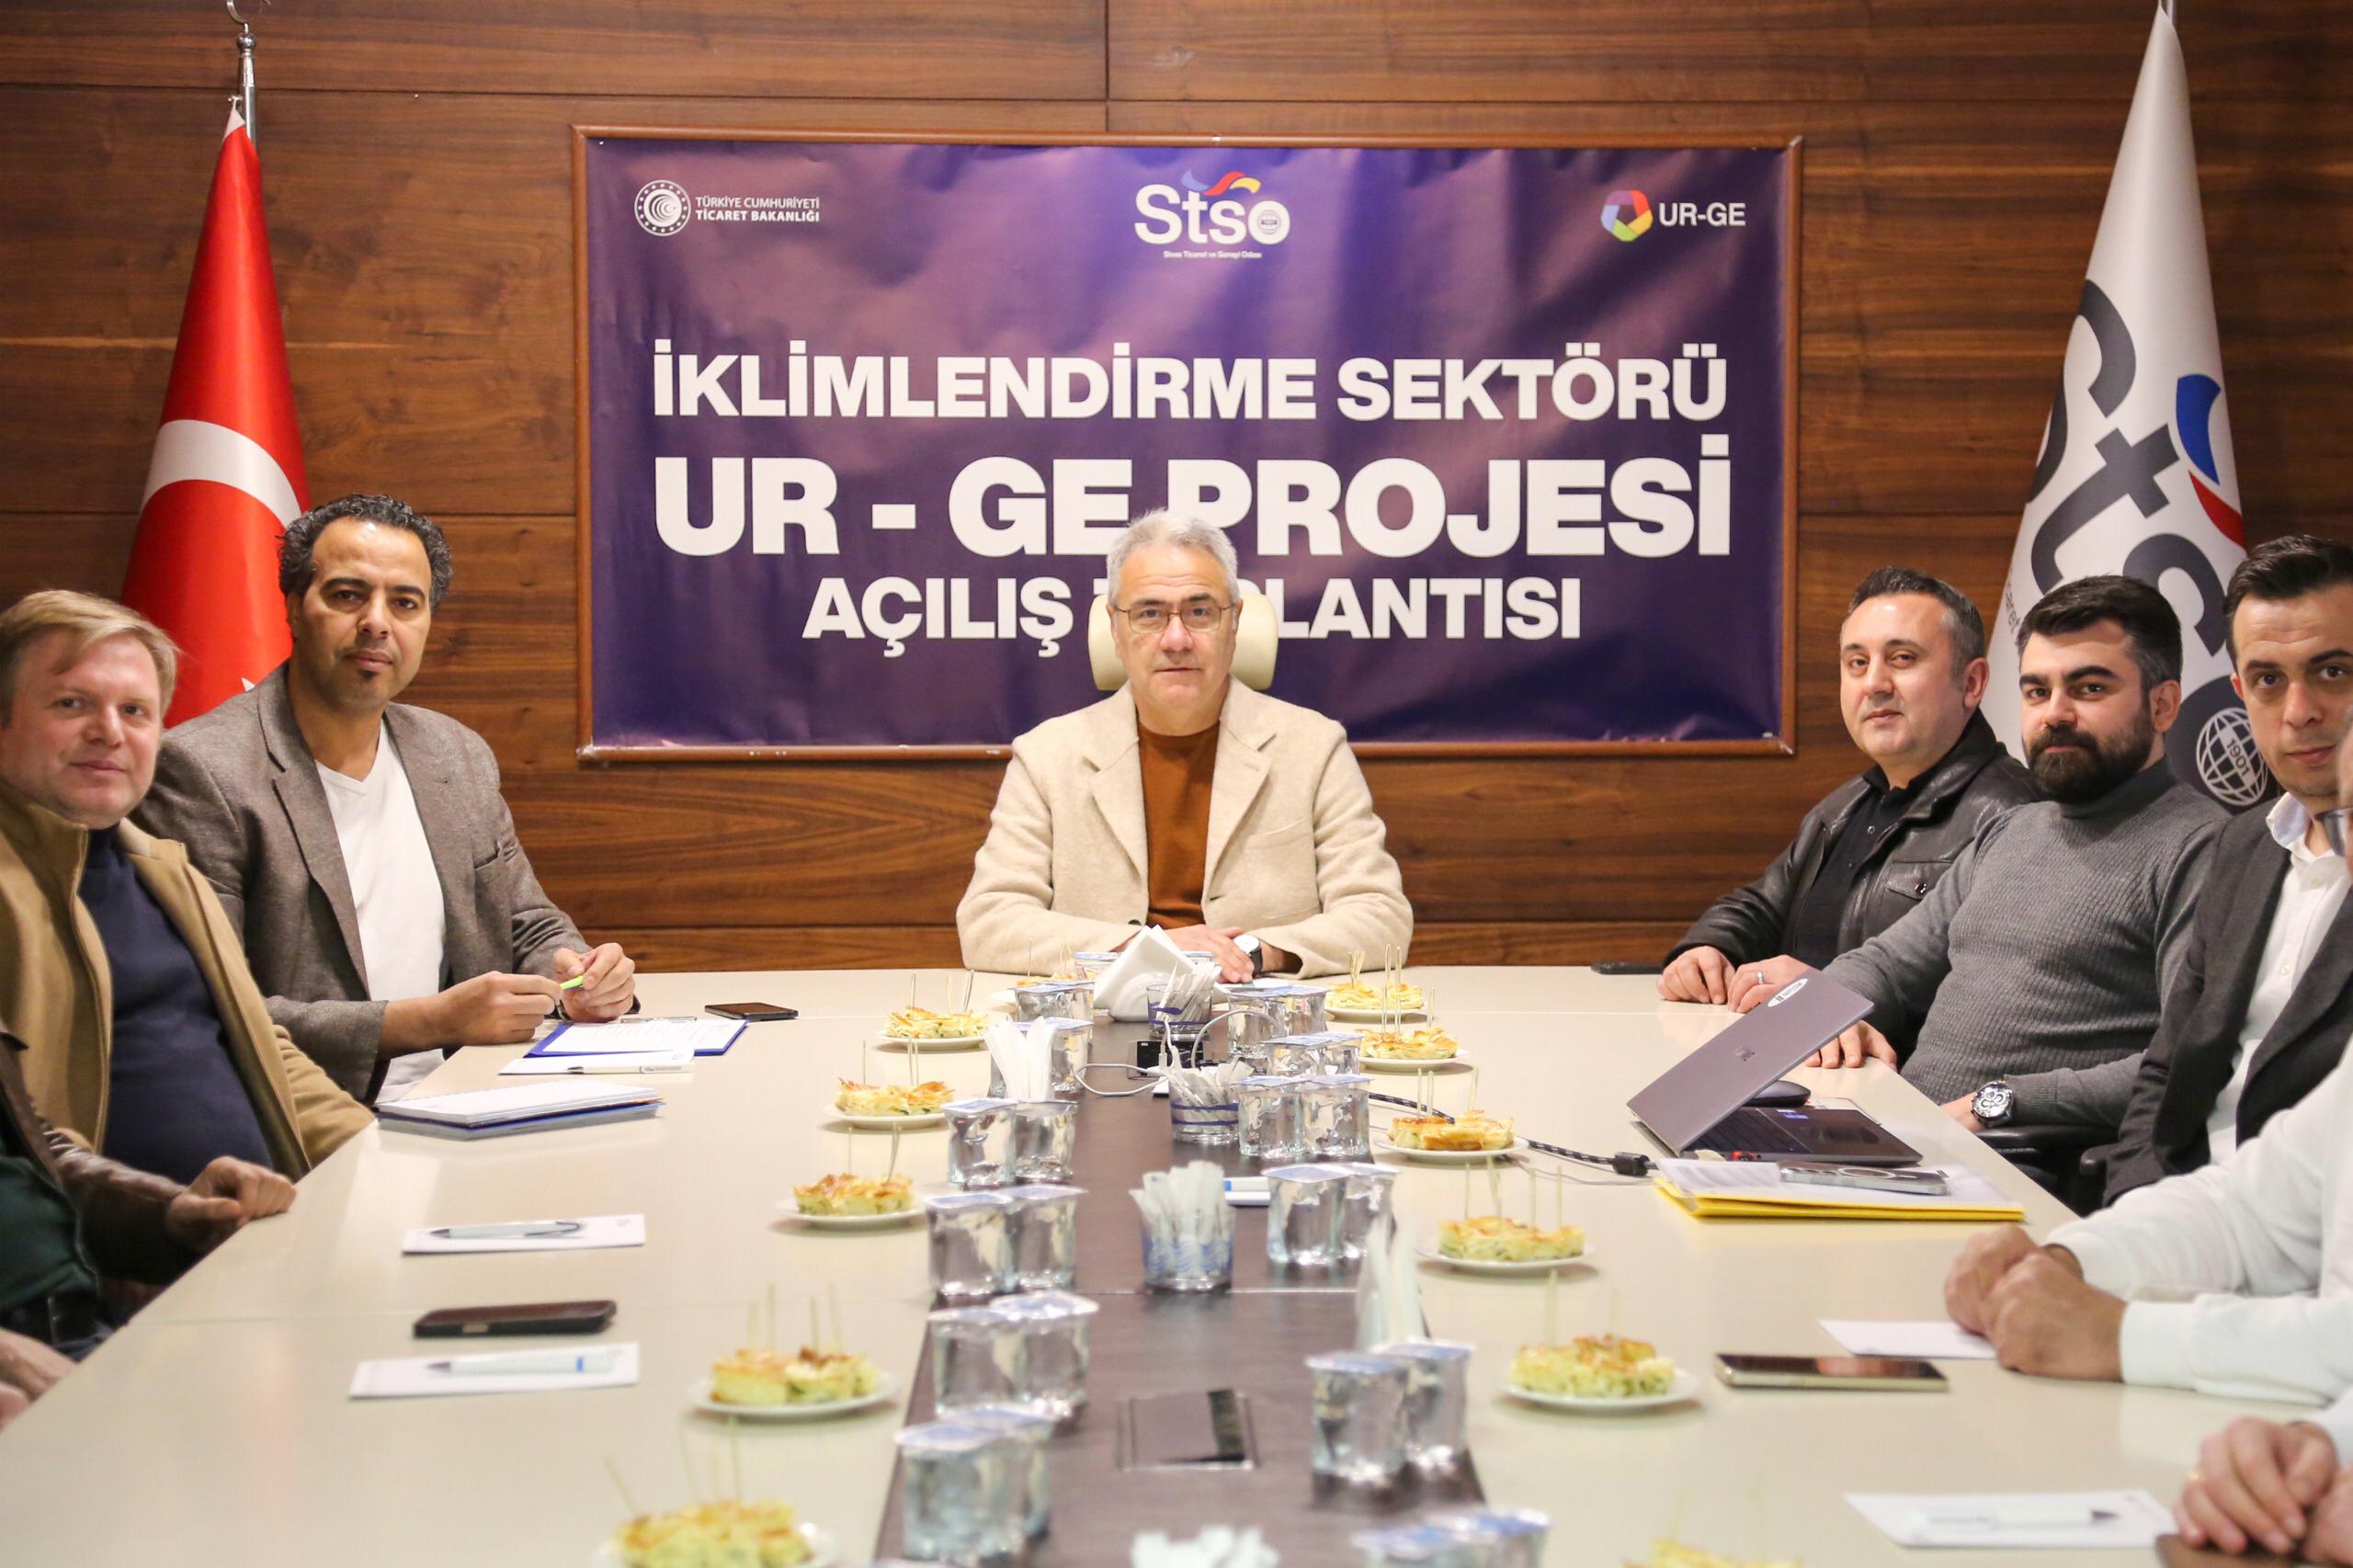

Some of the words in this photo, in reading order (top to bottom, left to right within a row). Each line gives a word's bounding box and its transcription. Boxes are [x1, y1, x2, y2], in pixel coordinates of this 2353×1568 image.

[695, 195, 742, 209] TÜRKİYE
[743, 196, 820, 209] CUMHURİYETİ
[695, 209, 748, 222] TİCARET
[751, 210, 820, 222] BAKANLIĞI
[1134, 184, 1290, 245] Stso
[1659, 202, 1746, 227] UR-GE
[654, 338, 1316, 419] İKLİMLENDİRME
[1337, 342, 1726, 421] SEKTÖRÜ
[655, 457, 840, 556] UR
[949, 456, 1133, 557] GE
[1166, 434, 1731, 557] PROJESİ
[801, 576, 1074, 657] AÇILIŞ
[1094, 576, 1581, 639] LANTISI
[2226, 738, 2251, 777] 1901
